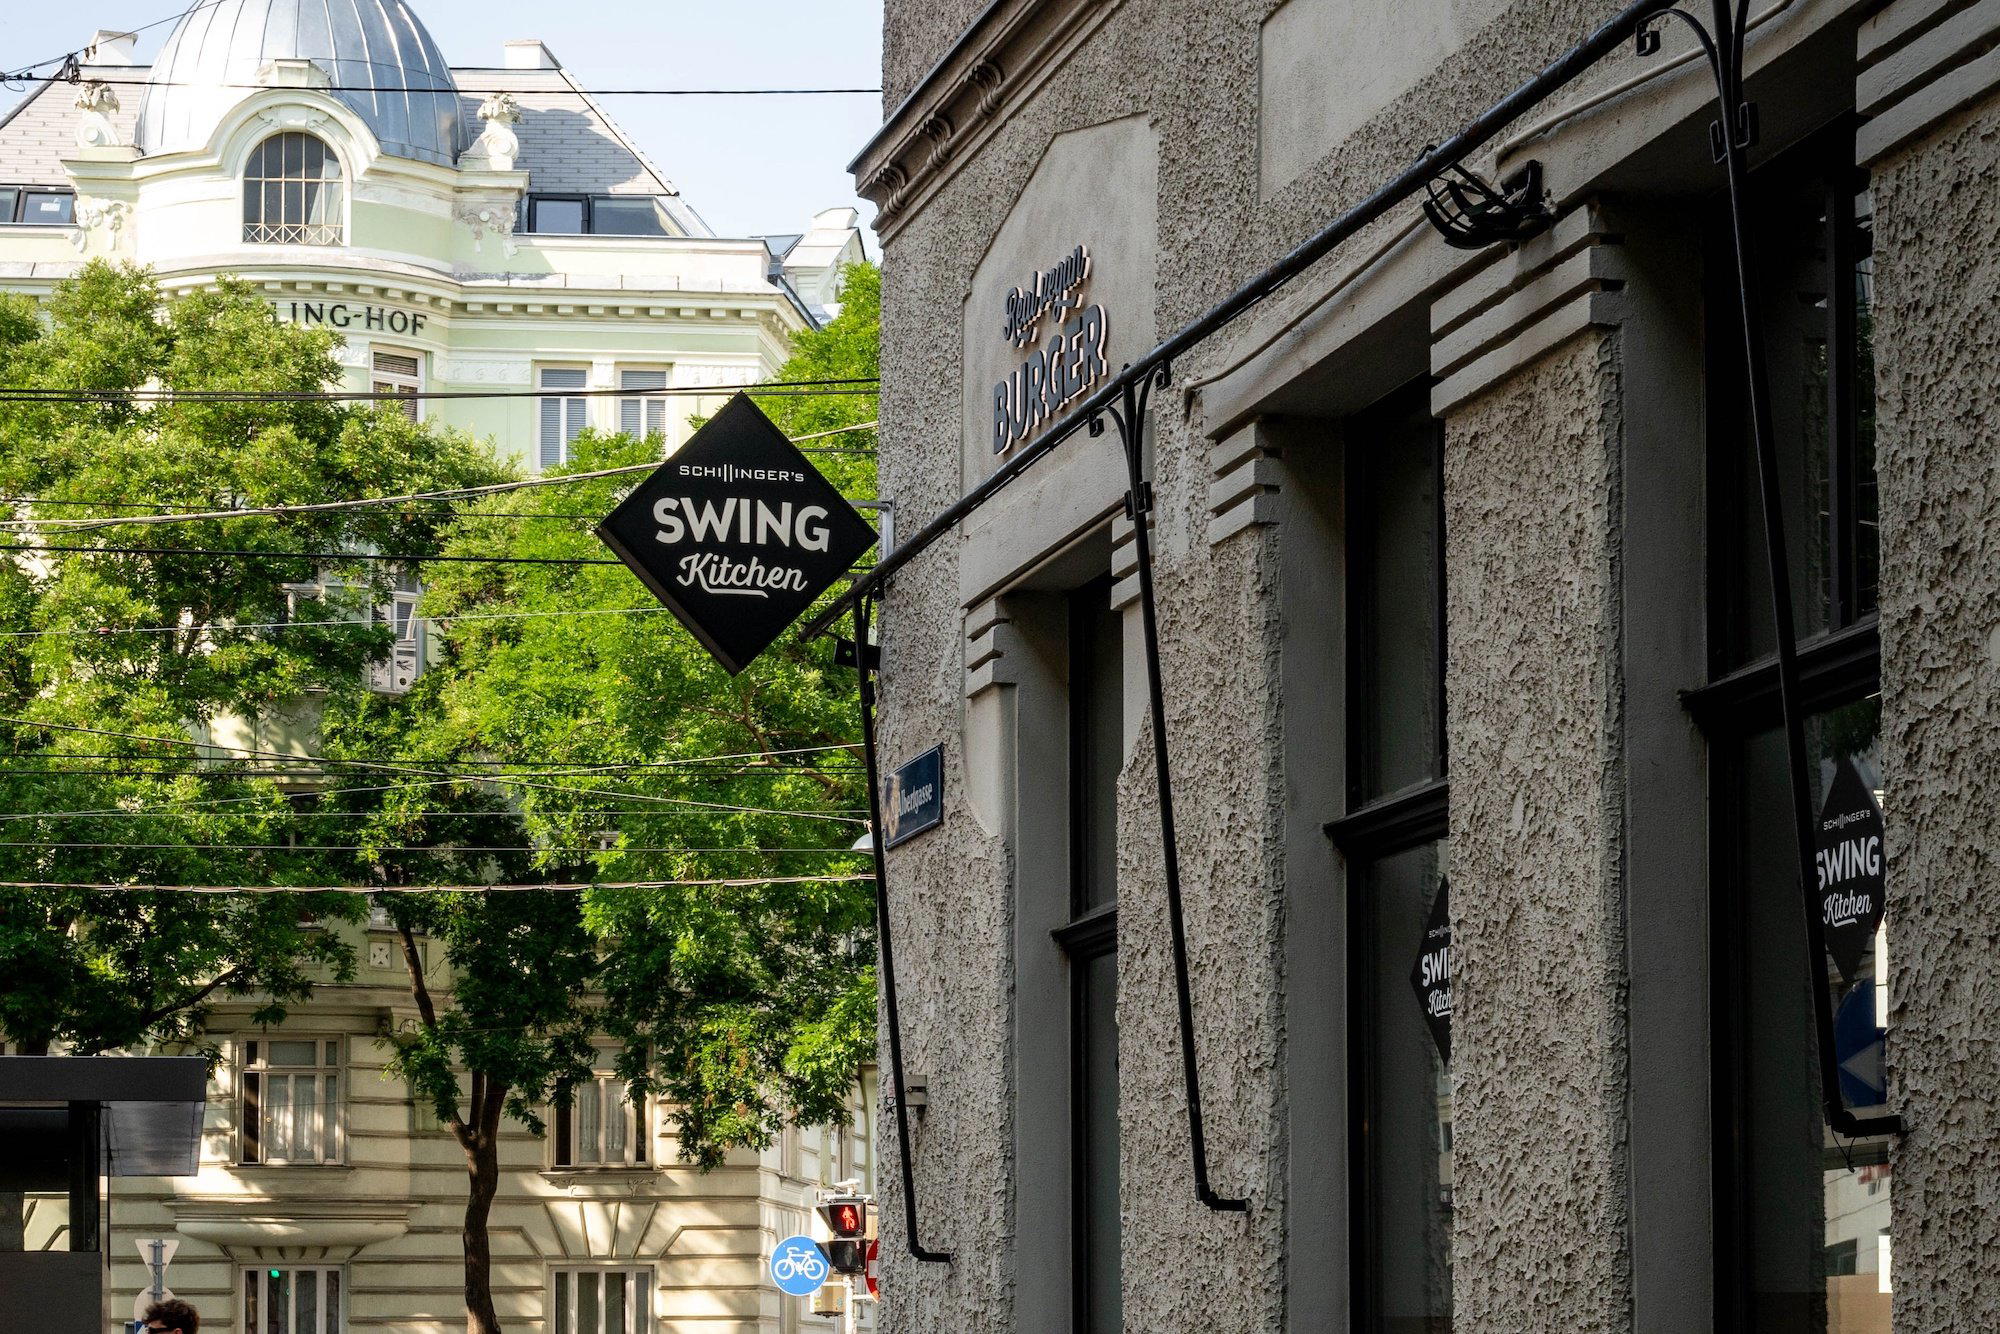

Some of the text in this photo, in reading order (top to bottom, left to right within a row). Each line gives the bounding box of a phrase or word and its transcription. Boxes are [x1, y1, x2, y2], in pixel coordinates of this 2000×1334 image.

[1003, 271, 1043, 348] Real
[993, 304, 1108, 455] BURGER
[653, 497, 830, 552] SWING
[676, 552, 808, 598] Kitchen
[1816, 836, 1880, 891] SWING
[1823, 889, 1873, 927] Kitchen
